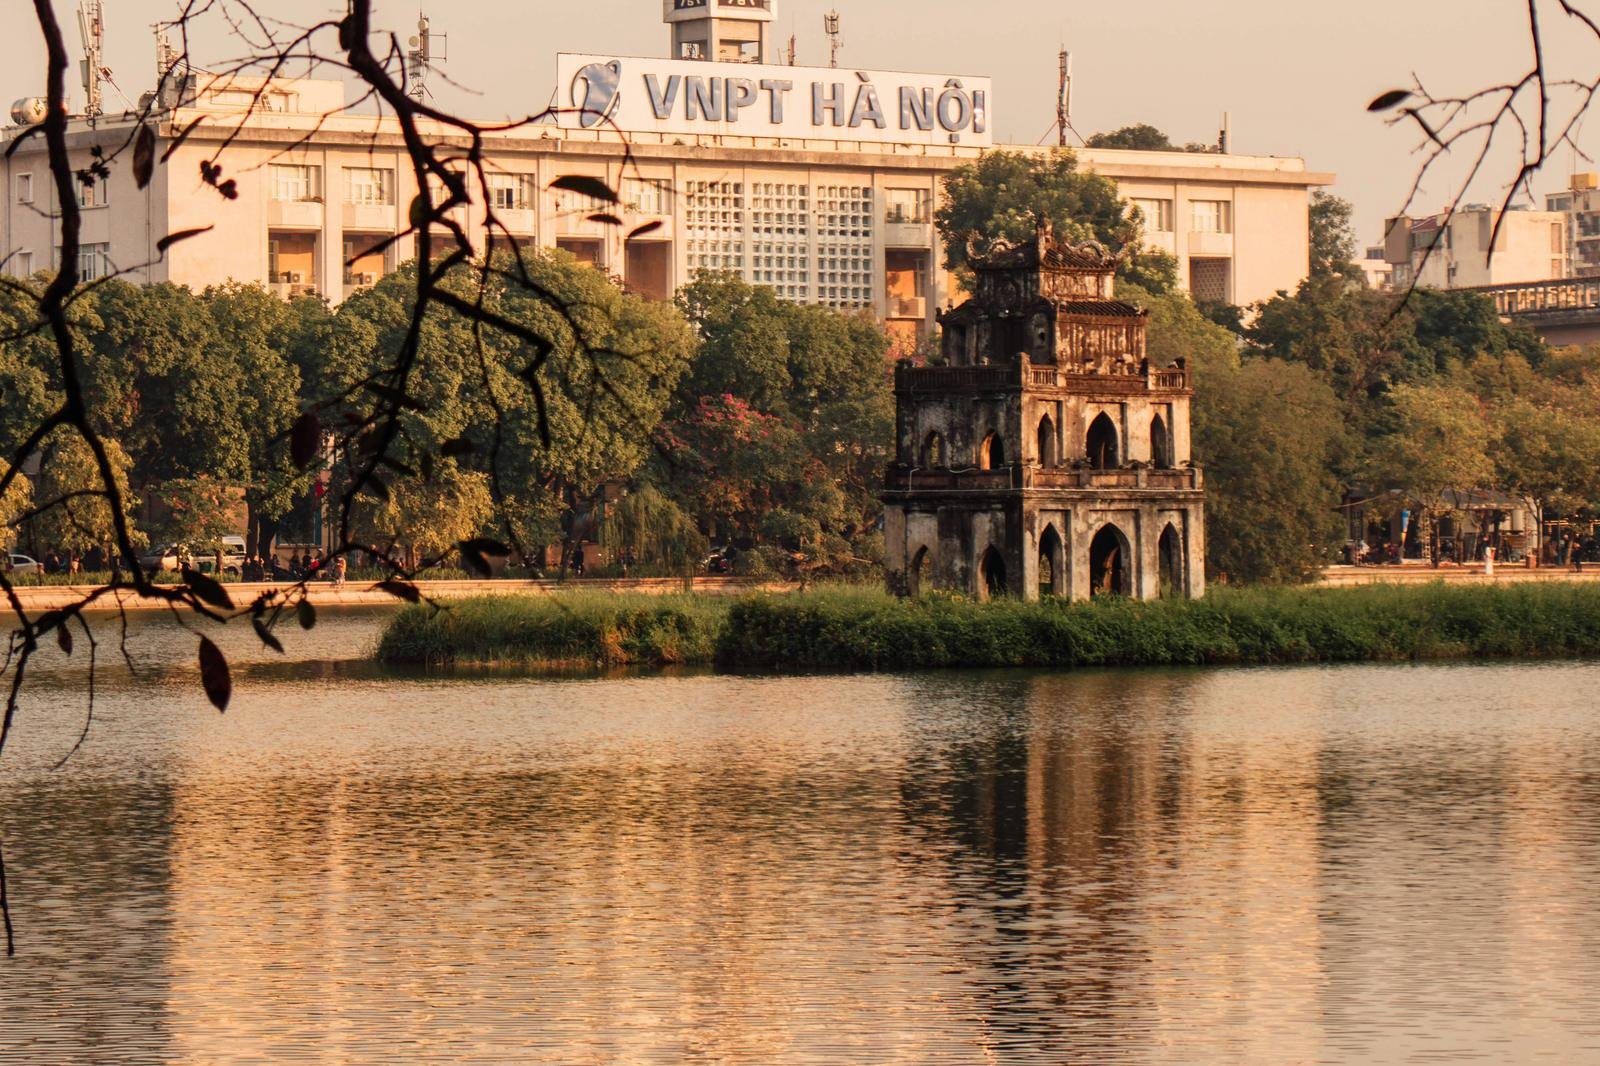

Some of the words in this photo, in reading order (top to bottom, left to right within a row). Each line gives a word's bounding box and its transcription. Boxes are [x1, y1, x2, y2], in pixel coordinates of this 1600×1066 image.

[643, 73, 793, 124] VNPT
[811, 71, 887, 129] HÀ
[898, 78, 986, 143] NỘI
